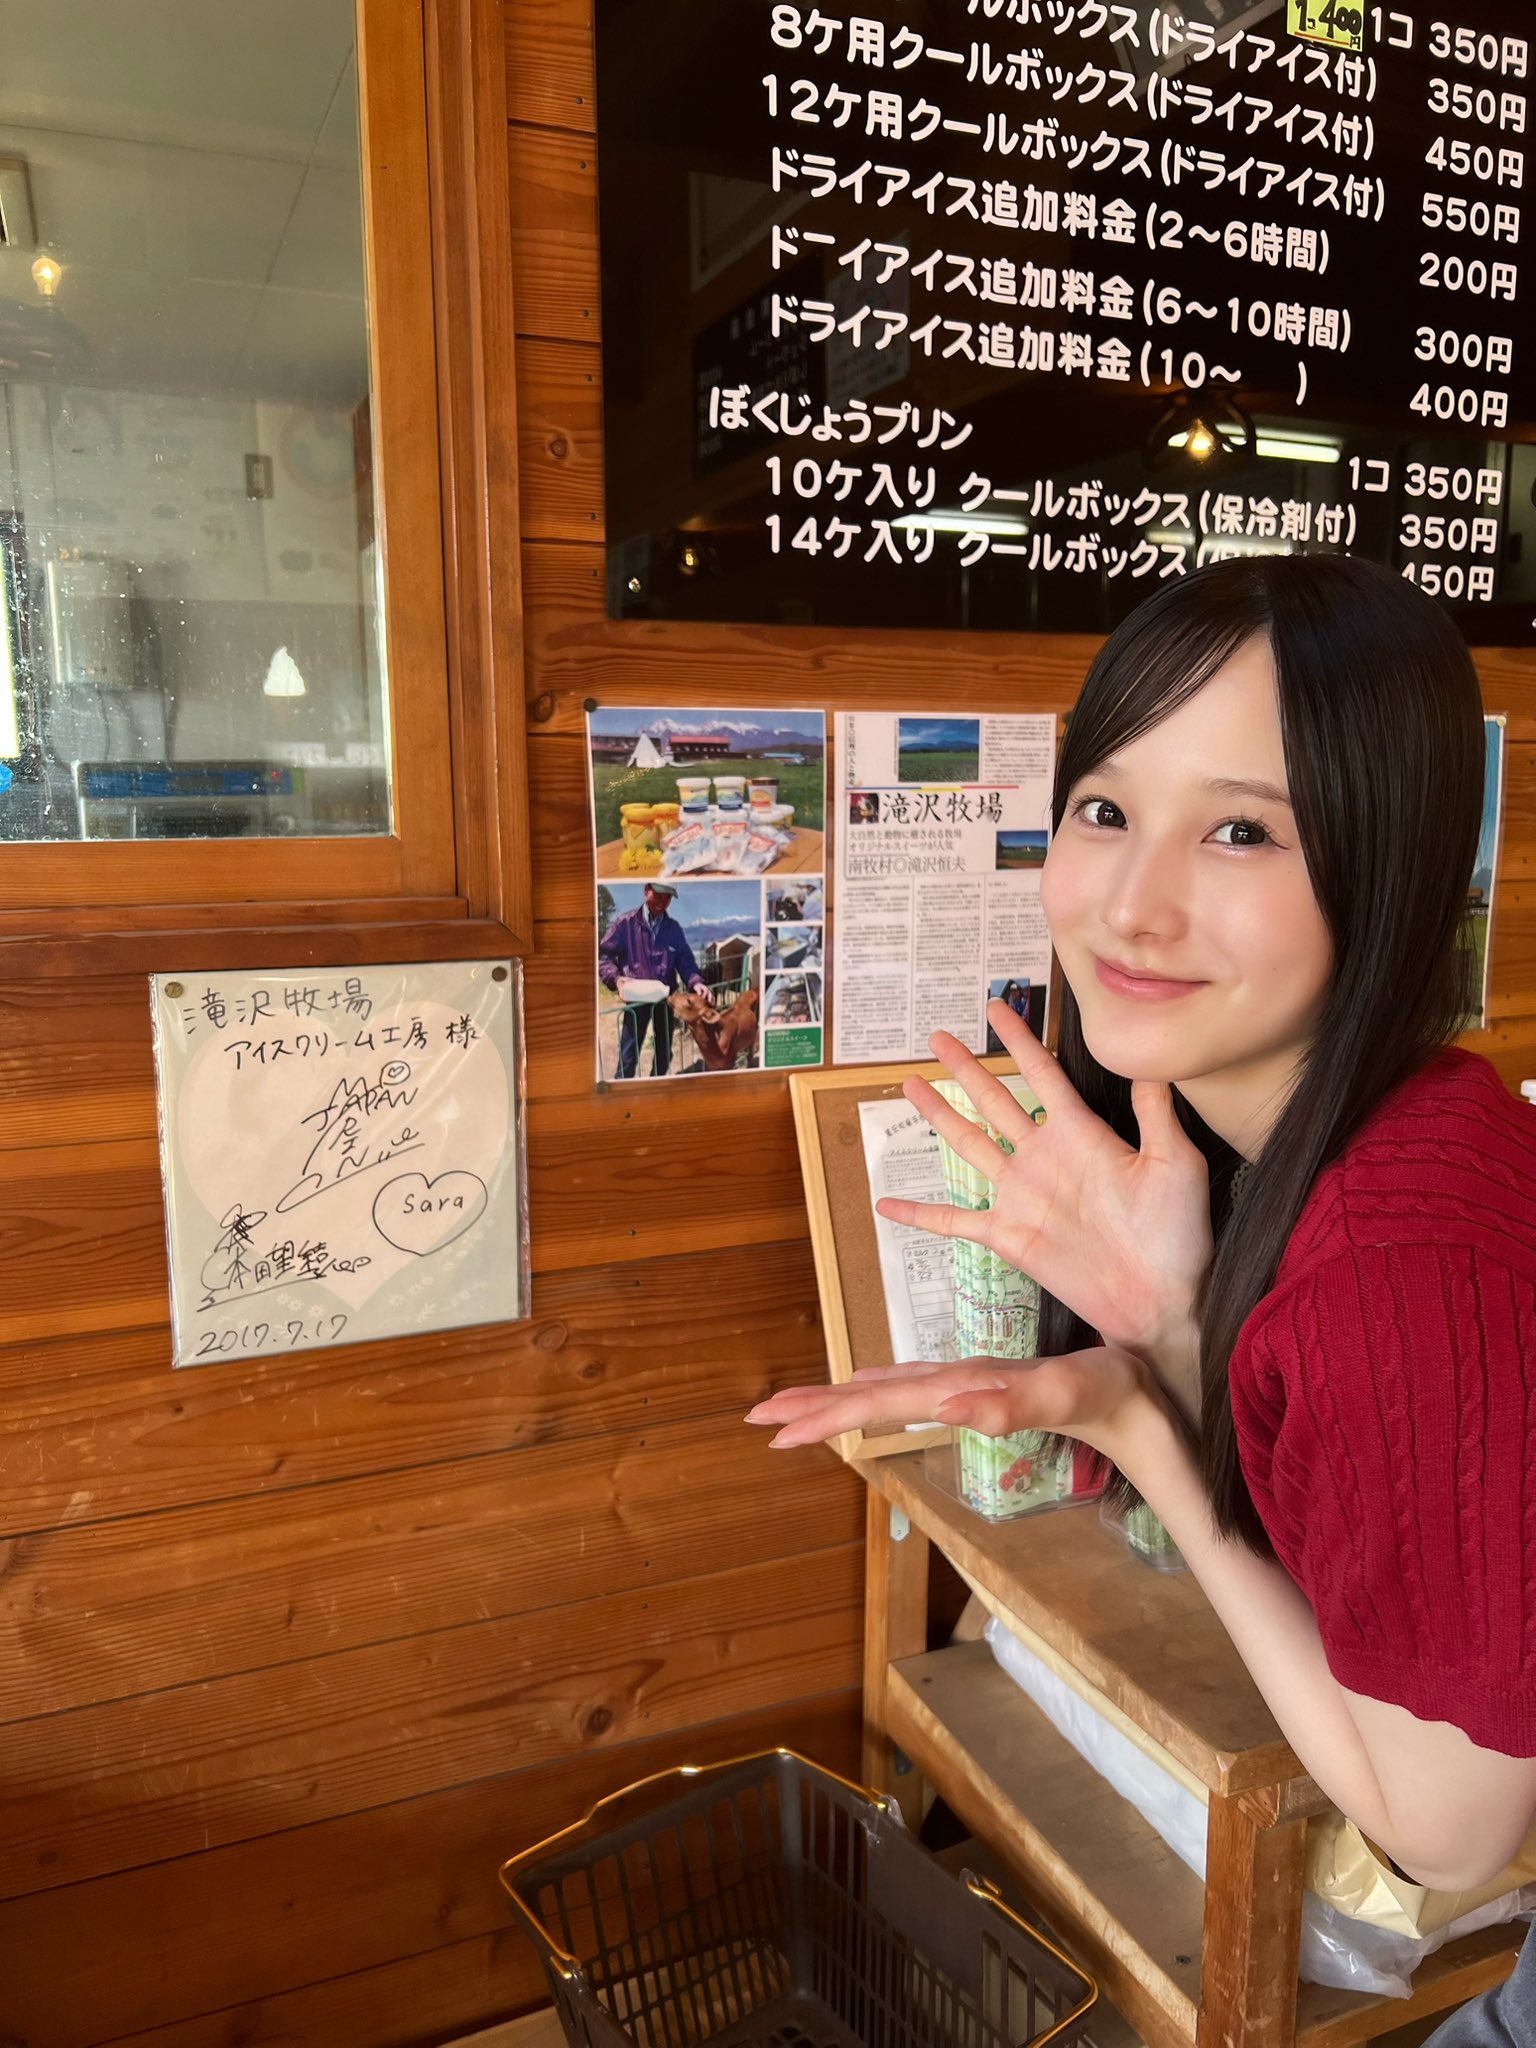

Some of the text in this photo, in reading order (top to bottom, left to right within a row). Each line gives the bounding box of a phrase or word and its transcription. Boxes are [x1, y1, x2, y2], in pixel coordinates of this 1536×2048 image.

[1371, 6, 1528, 78] 1コ 350円
[1427, 78, 1527, 133] 350円
[1425, 136, 1524, 189] 450円
[1421, 192, 1520, 244] 550円
[1419, 252, 1517, 301] 200円
[1414, 326, 1513, 374] 300円
[1409, 383, 1508, 428] 400円
[709, 384, 1503, 506] ぼくじょうプリン 1コ 350円
[1399, 514, 1498, 554] 350円
[882, 792, 1004, 825] 滝沢牧場
[183, 978, 373, 1035] 滝沢牧場
[445, 1013, 482, 1050] 様
[402, 1193, 464, 1214] Sara
[196, 1313, 349, 1358] 2017.7.17
